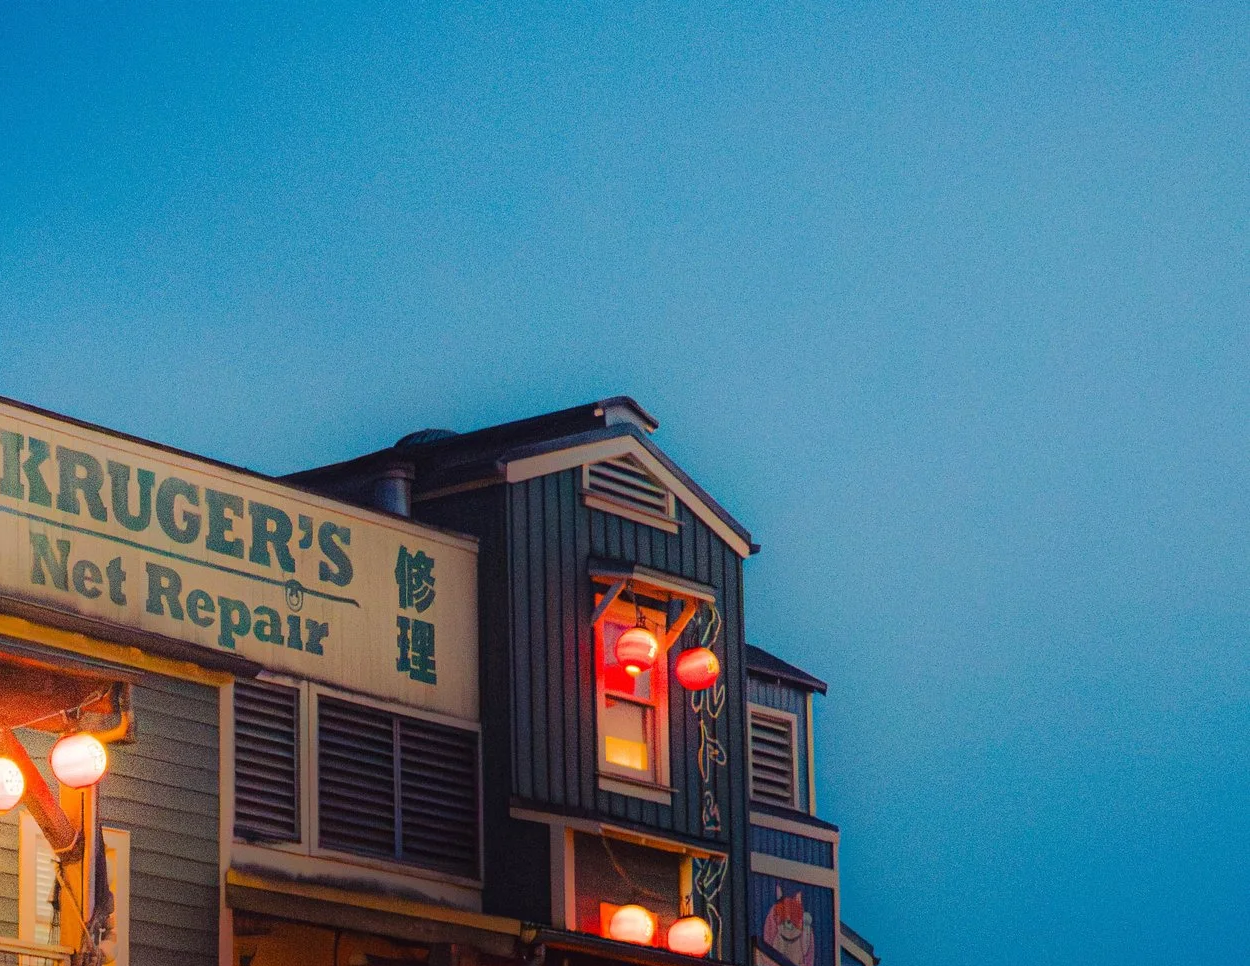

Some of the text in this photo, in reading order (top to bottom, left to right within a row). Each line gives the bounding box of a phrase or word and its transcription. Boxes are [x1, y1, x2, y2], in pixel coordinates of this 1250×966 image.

[0, 428, 355, 587] KRUGER'S
[30, 531, 329, 656] Net Repair
[395, 544, 438, 685] 修理
